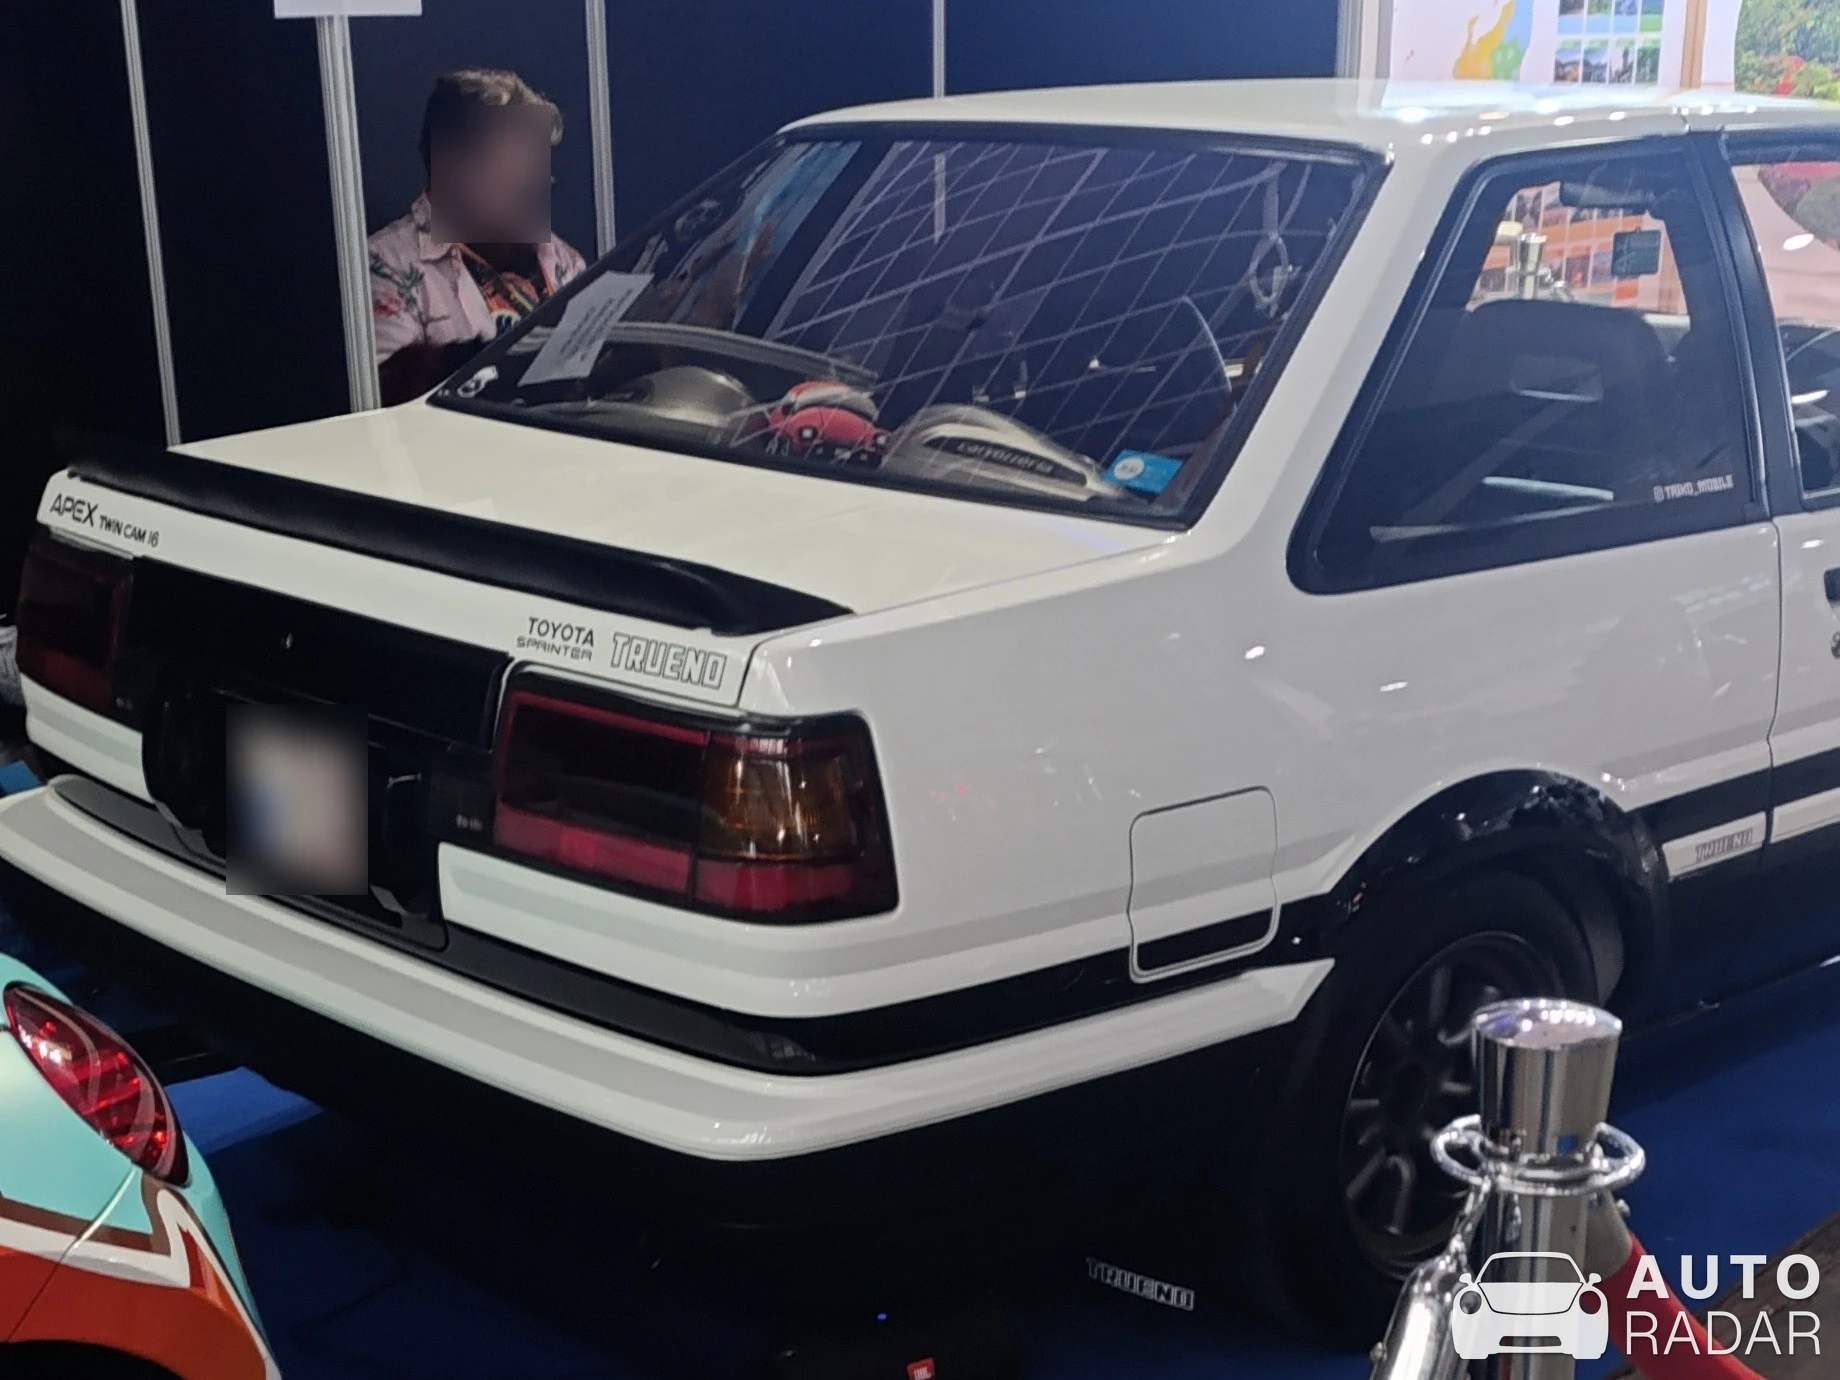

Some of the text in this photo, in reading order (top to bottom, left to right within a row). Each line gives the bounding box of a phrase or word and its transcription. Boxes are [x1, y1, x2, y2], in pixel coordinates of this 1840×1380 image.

[50, 493, 160, 548] APEX TWIN CAM 16
[516, 636, 593, 662] SPRINTER
[528, 616, 594, 647] TOYOTA
[611, 632, 728, 690] TRUENO
[1086, 1257, 1195, 1311] TRUENO
